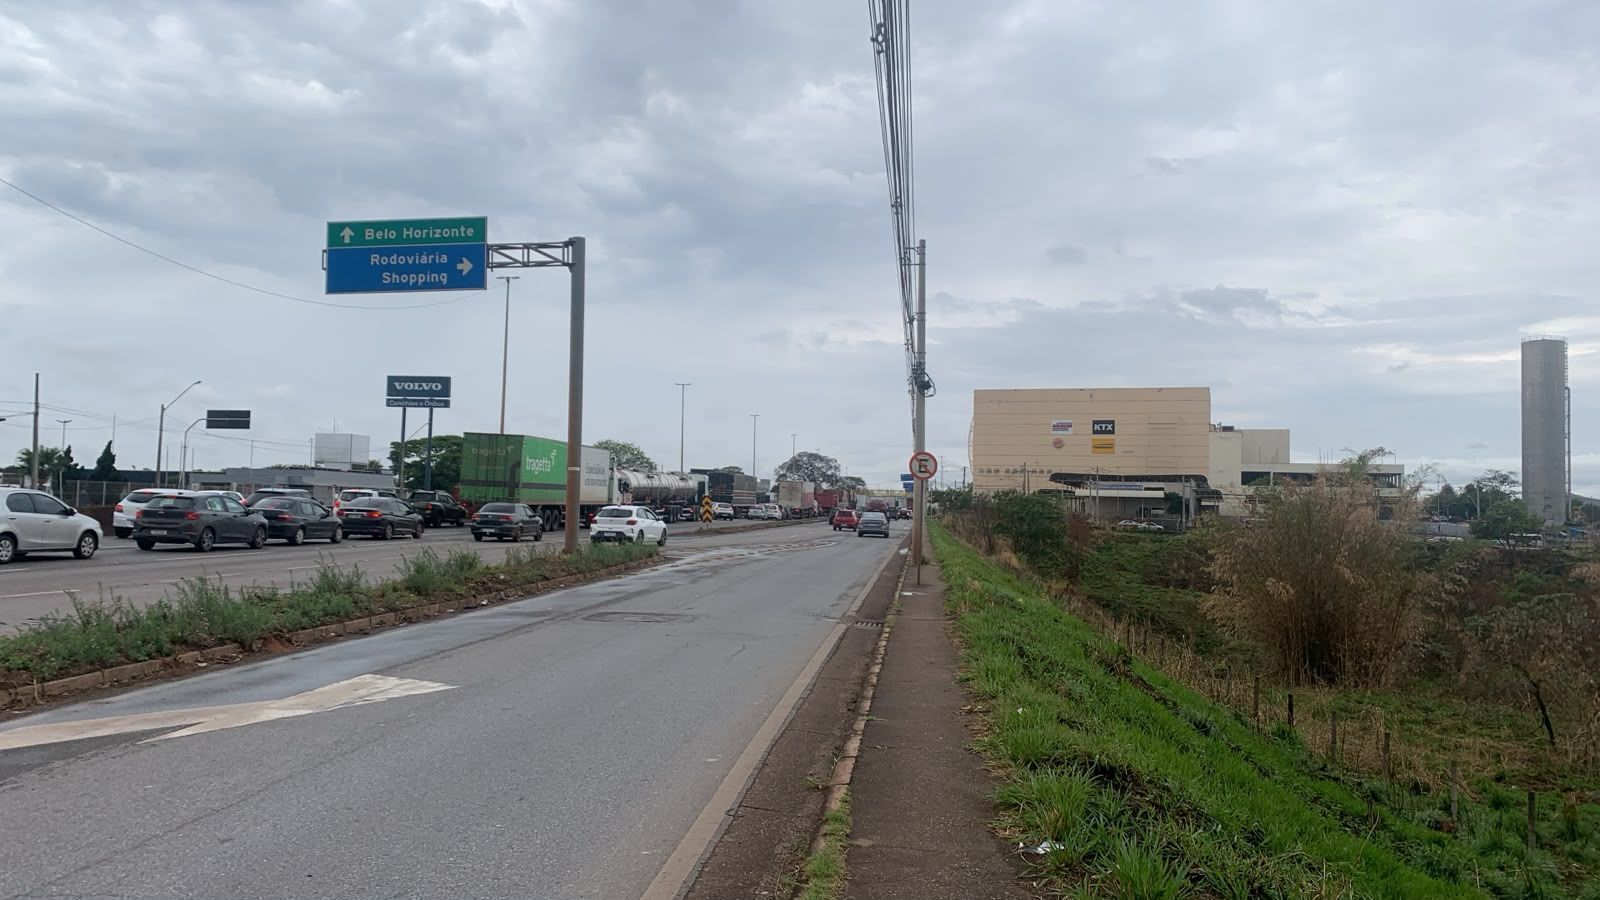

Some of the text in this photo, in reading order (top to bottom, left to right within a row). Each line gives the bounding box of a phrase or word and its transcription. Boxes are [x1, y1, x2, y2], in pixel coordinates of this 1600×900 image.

[364, 225, 475, 240] Belo Horizonte
[370, 252, 448, 266] Rodoviária
[381, 272, 448, 286] Shopping
[393, 382, 442, 391] VOLVO
[1094, 423, 1113, 431] KTX
[526, 455, 551, 474] tragetta
[919, 458, 929, 473] E
